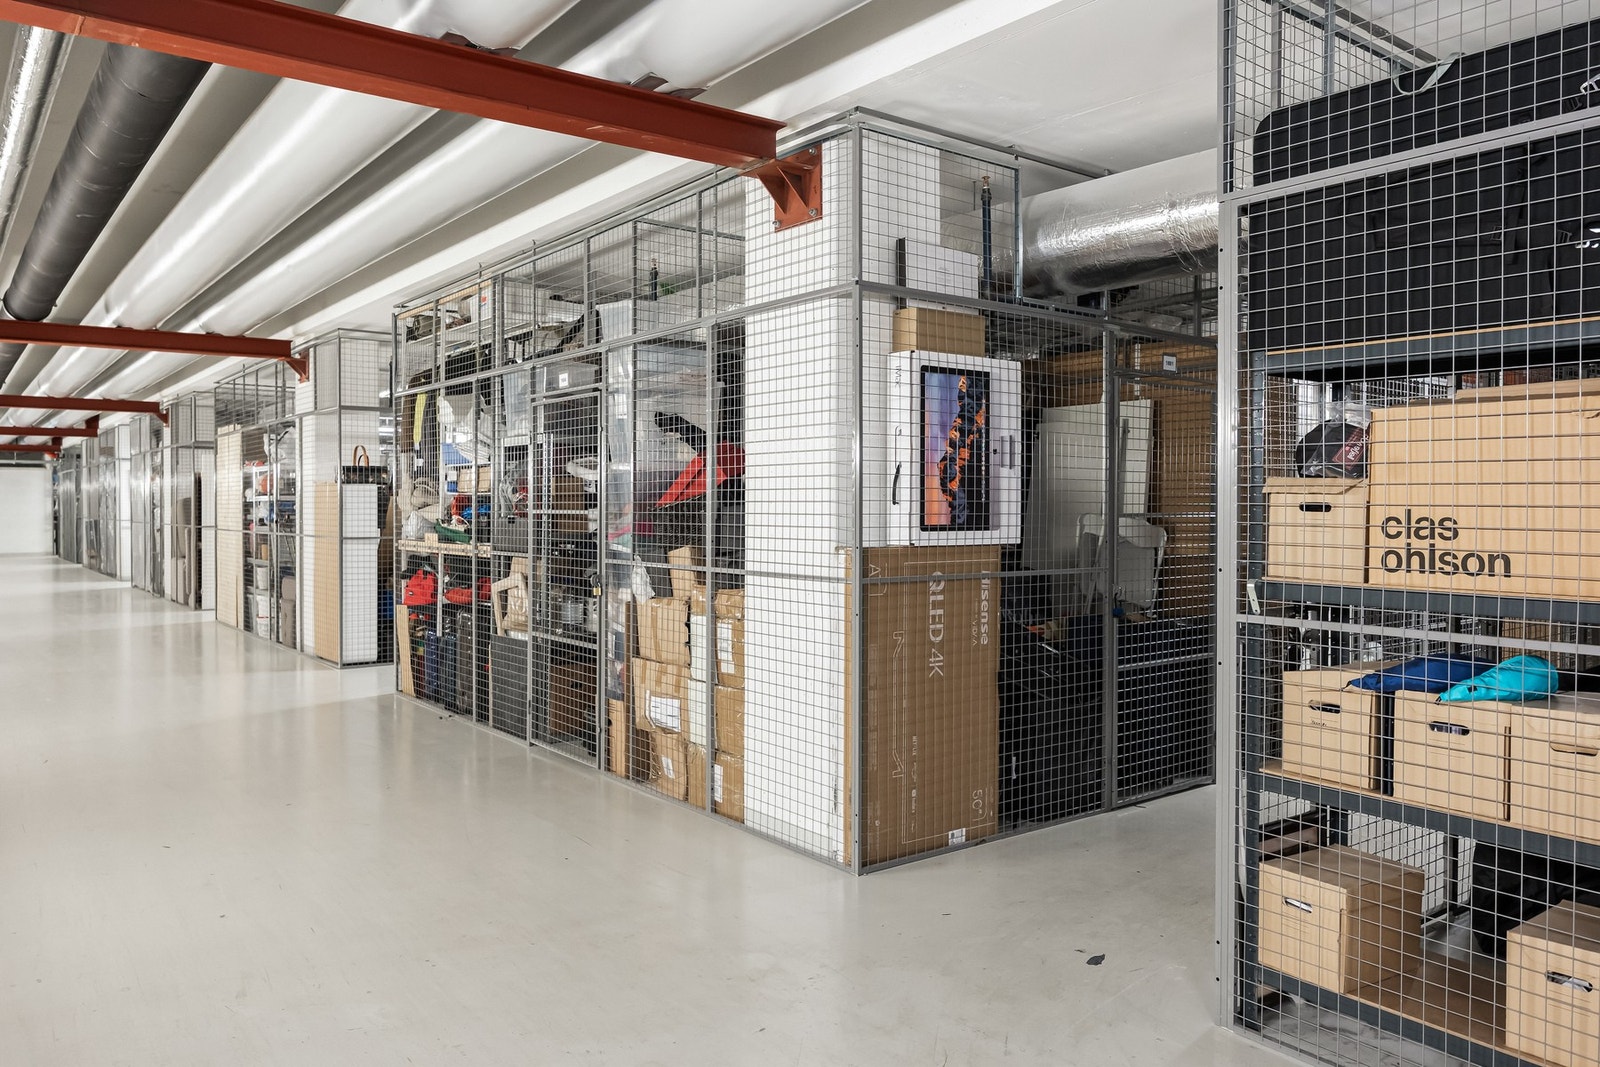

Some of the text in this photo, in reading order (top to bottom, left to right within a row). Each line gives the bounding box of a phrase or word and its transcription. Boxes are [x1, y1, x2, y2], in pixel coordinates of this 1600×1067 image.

[1381, 509, 1459, 541] clas
[1380, 543, 1512, 578] ohlson
[928, 572, 945, 678] QLED 4K
[980, 570, 990, 644] Hisense
